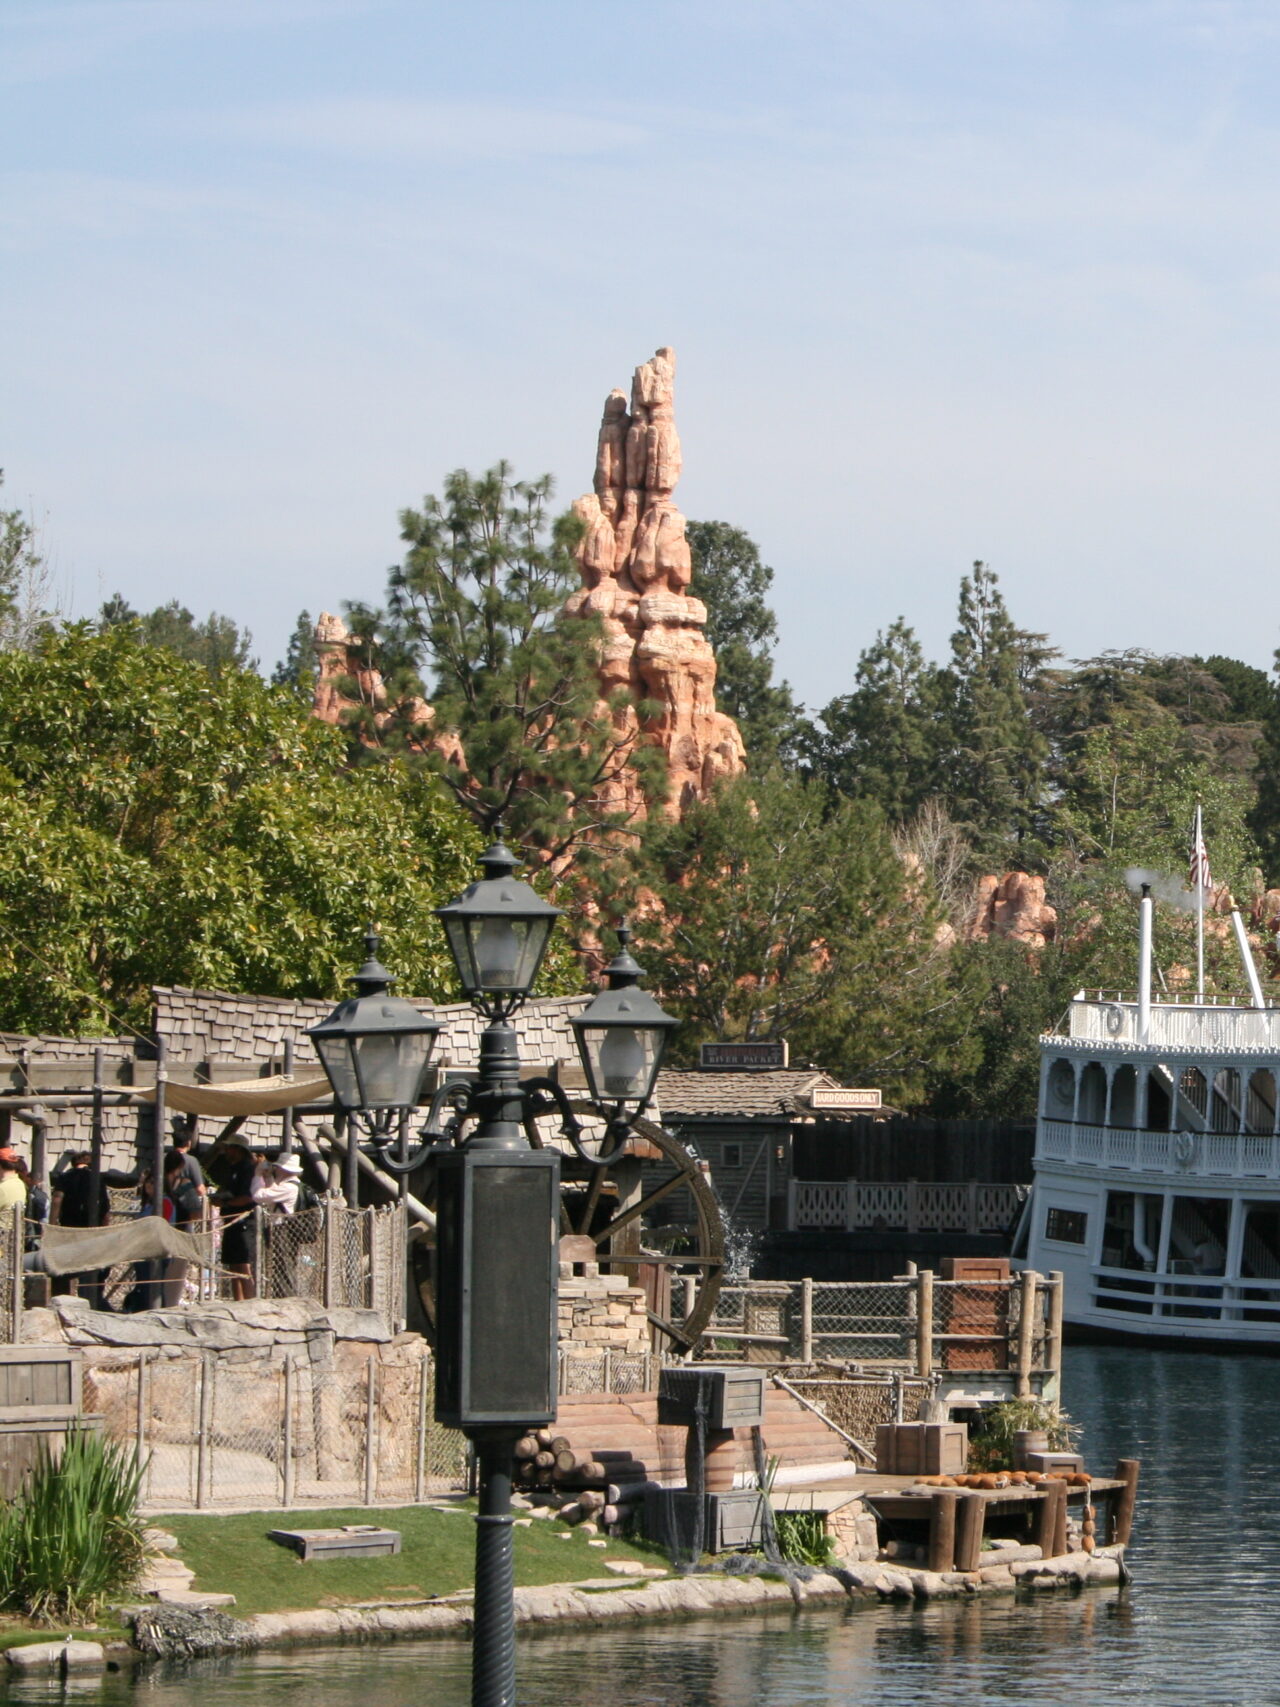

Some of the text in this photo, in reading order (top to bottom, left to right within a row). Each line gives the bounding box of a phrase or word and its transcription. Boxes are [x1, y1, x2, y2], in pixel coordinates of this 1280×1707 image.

[709, 1055, 778, 1063] RIVER PACKET
[816, 1092, 878, 1103] HARD GOODS ONLY
